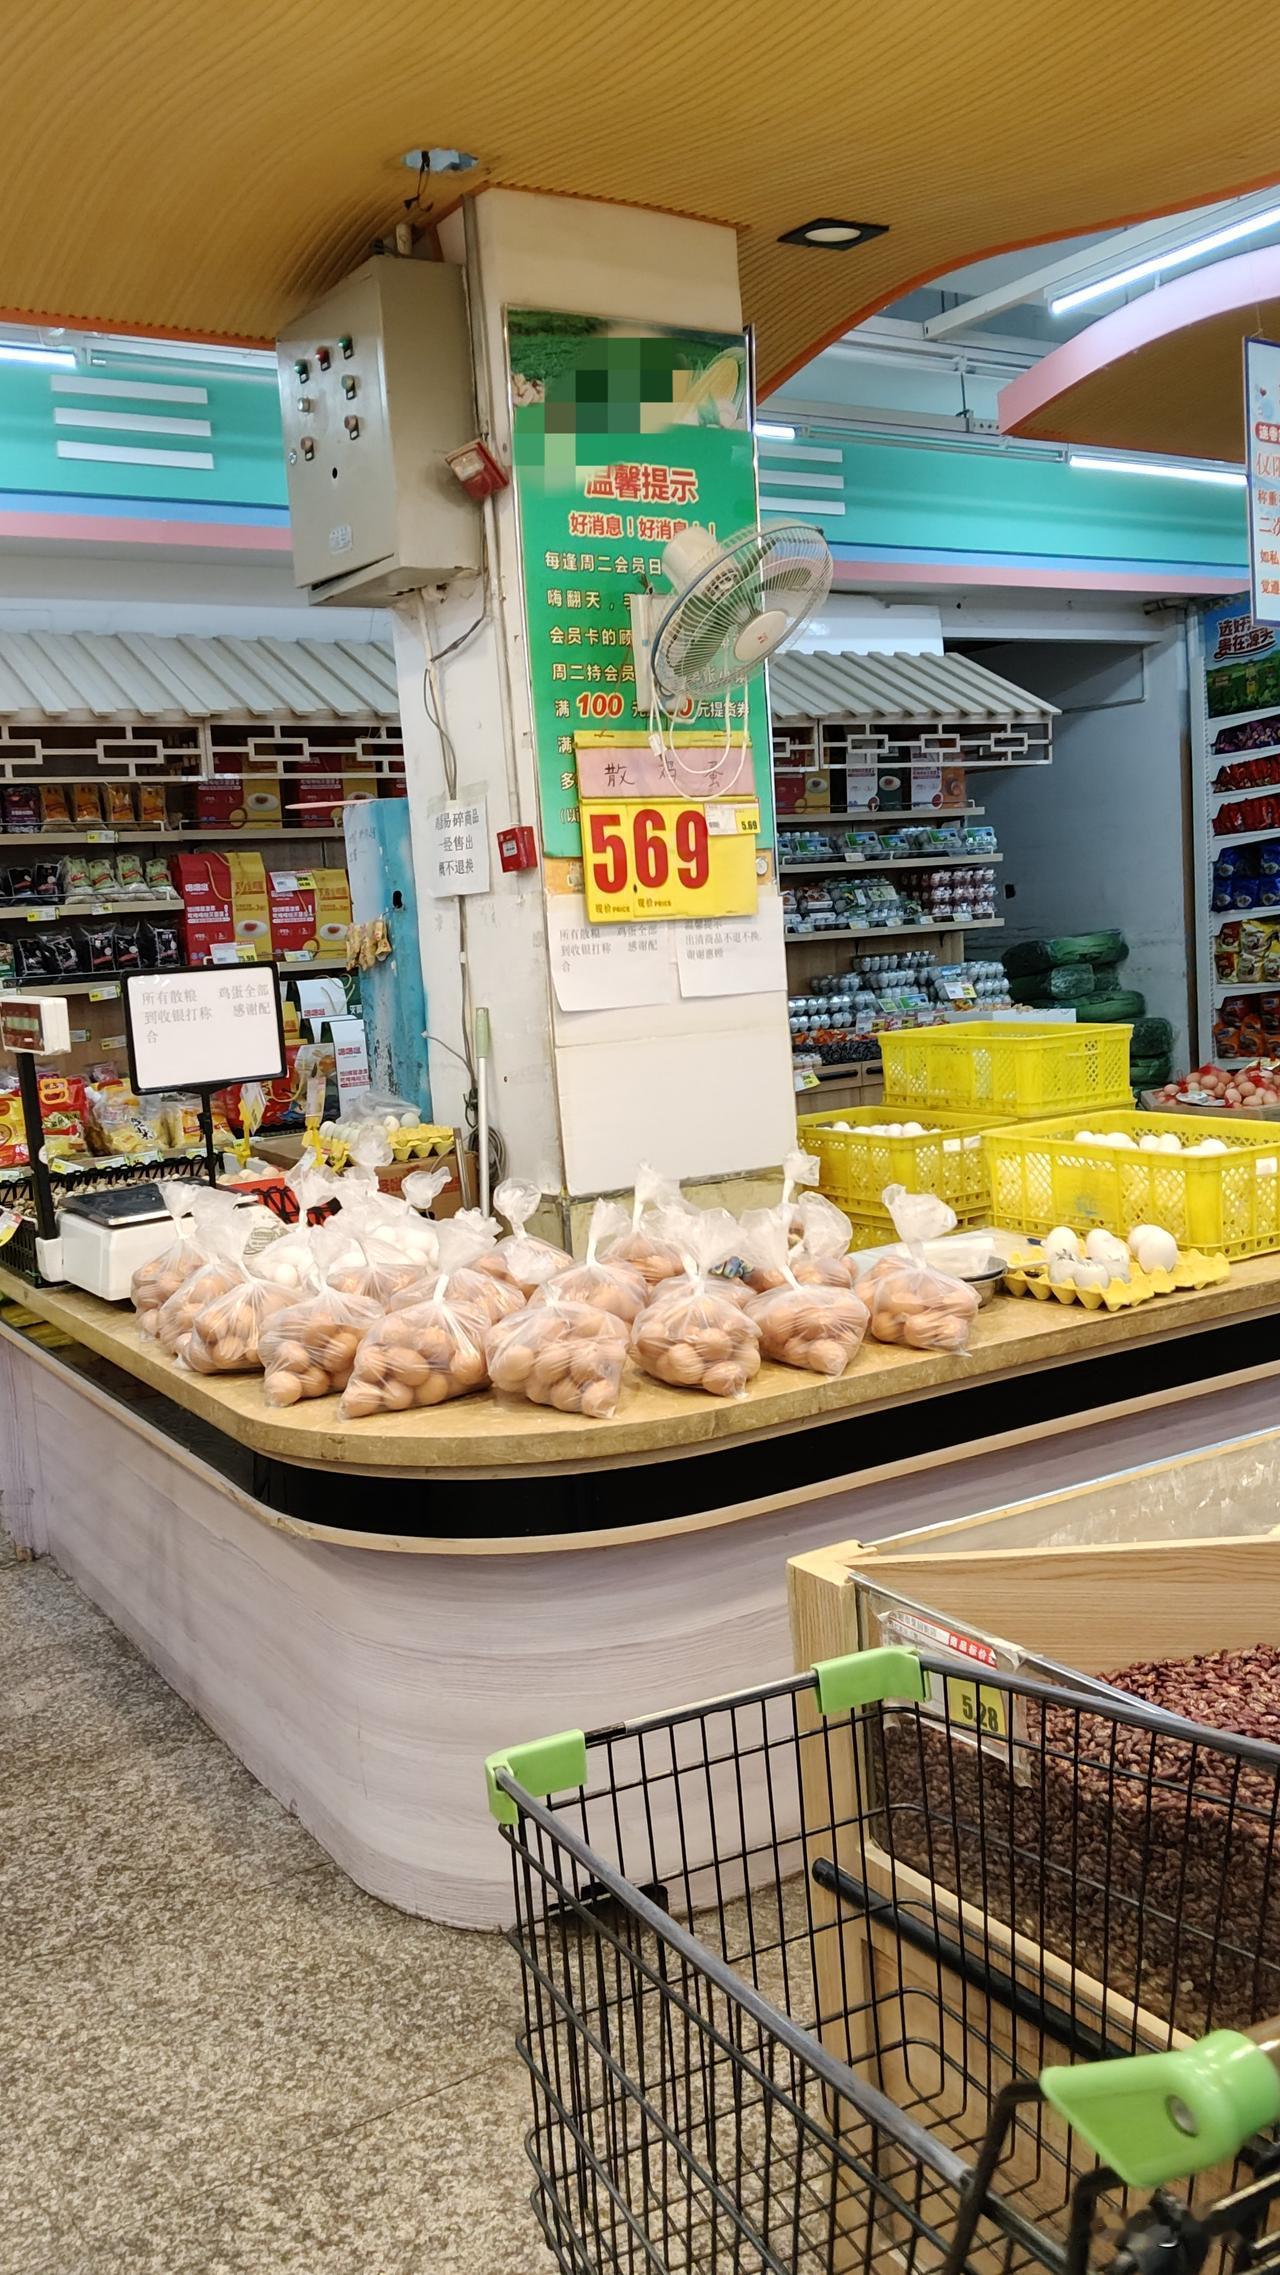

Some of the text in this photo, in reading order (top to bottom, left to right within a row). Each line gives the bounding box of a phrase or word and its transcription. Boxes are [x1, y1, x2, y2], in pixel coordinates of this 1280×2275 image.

[586, 464, 699, 503] 温馨提示
[545, 552, 662, 575] 每逢周二会员日
[552, 663, 635, 682] 周二持会员
[554, 699, 570, 717] 满
[576, 692, 624, 718] 100
[741, 820, 758, 830] 5.69
[439, 834, 474, 852] 一经售出
[612, 905, 631, 914] PRICE
[654, 900, 672, 909] PRICE
[144, 1002, 272, 1025] 到收银打称 感谢配
[147, 1030, 159, 1045] 合
[961, 1694, 999, 1732] 5.28
